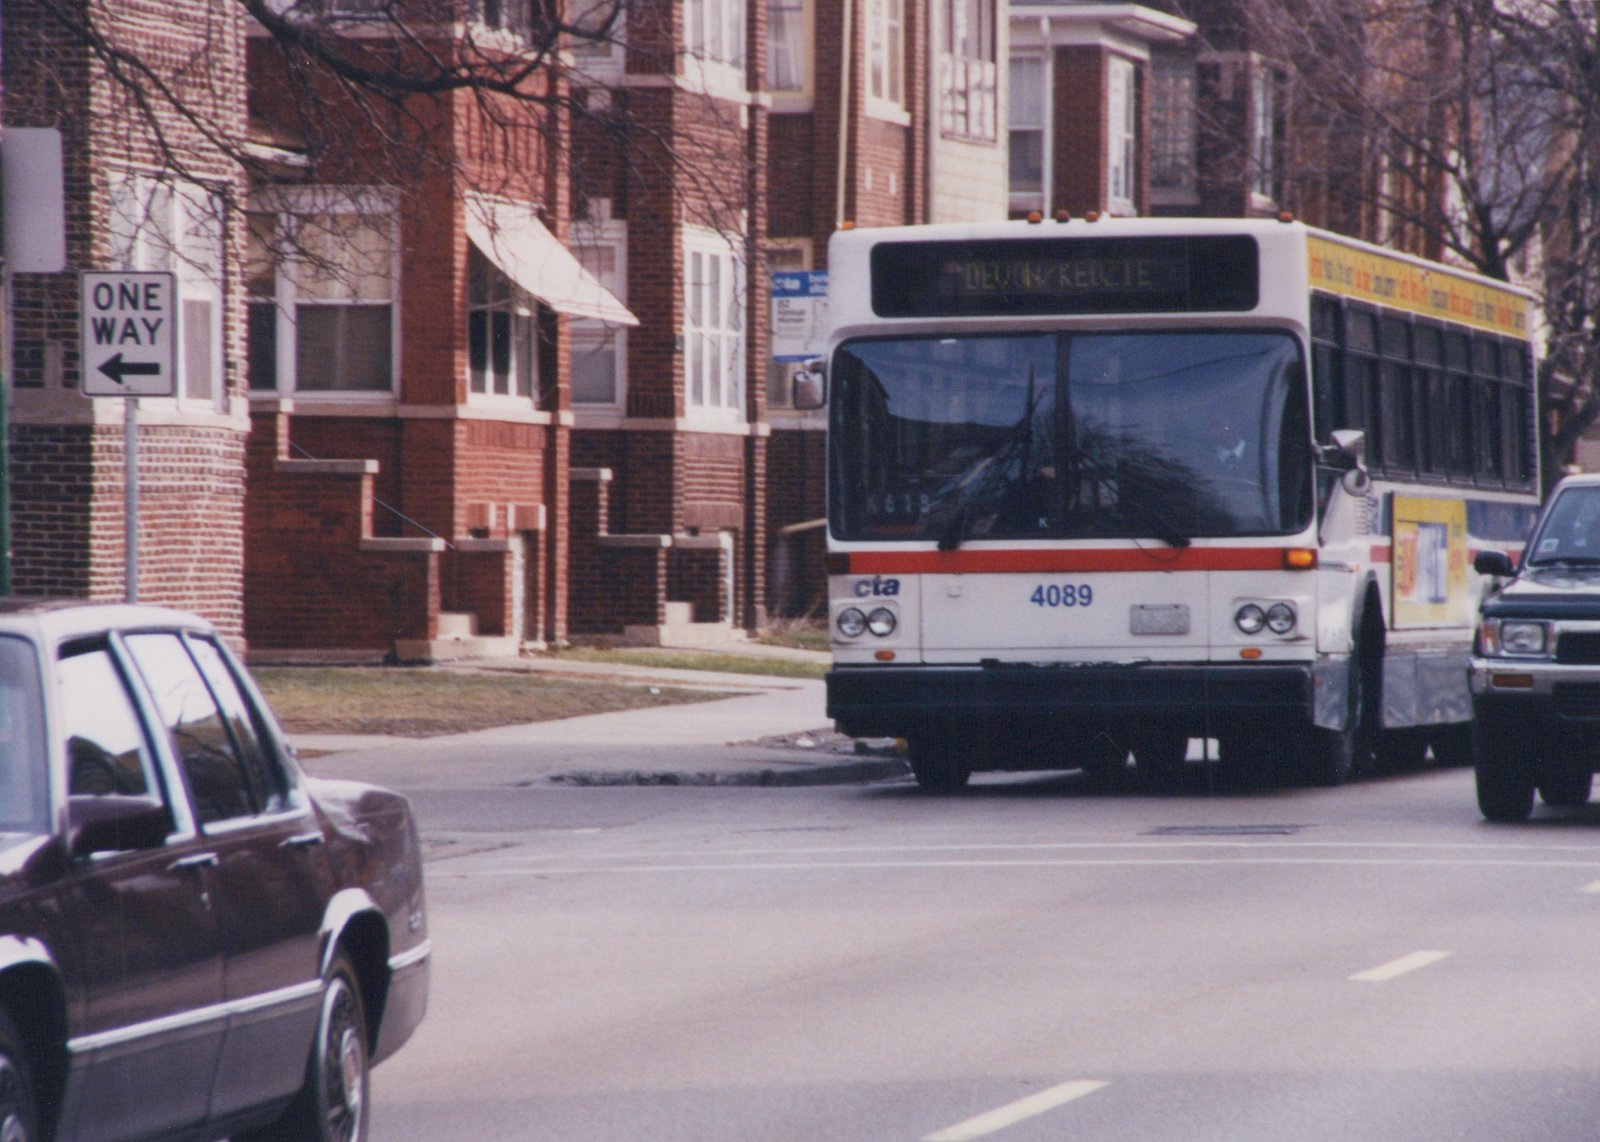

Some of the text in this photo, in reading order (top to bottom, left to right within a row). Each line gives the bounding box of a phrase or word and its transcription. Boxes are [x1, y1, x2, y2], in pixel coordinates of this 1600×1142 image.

[94, 282, 162, 310] ONE
[91, 317, 163, 345] WAY
[854, 575, 900, 598] cta
[1030, 584, 1093, 607] 4089
